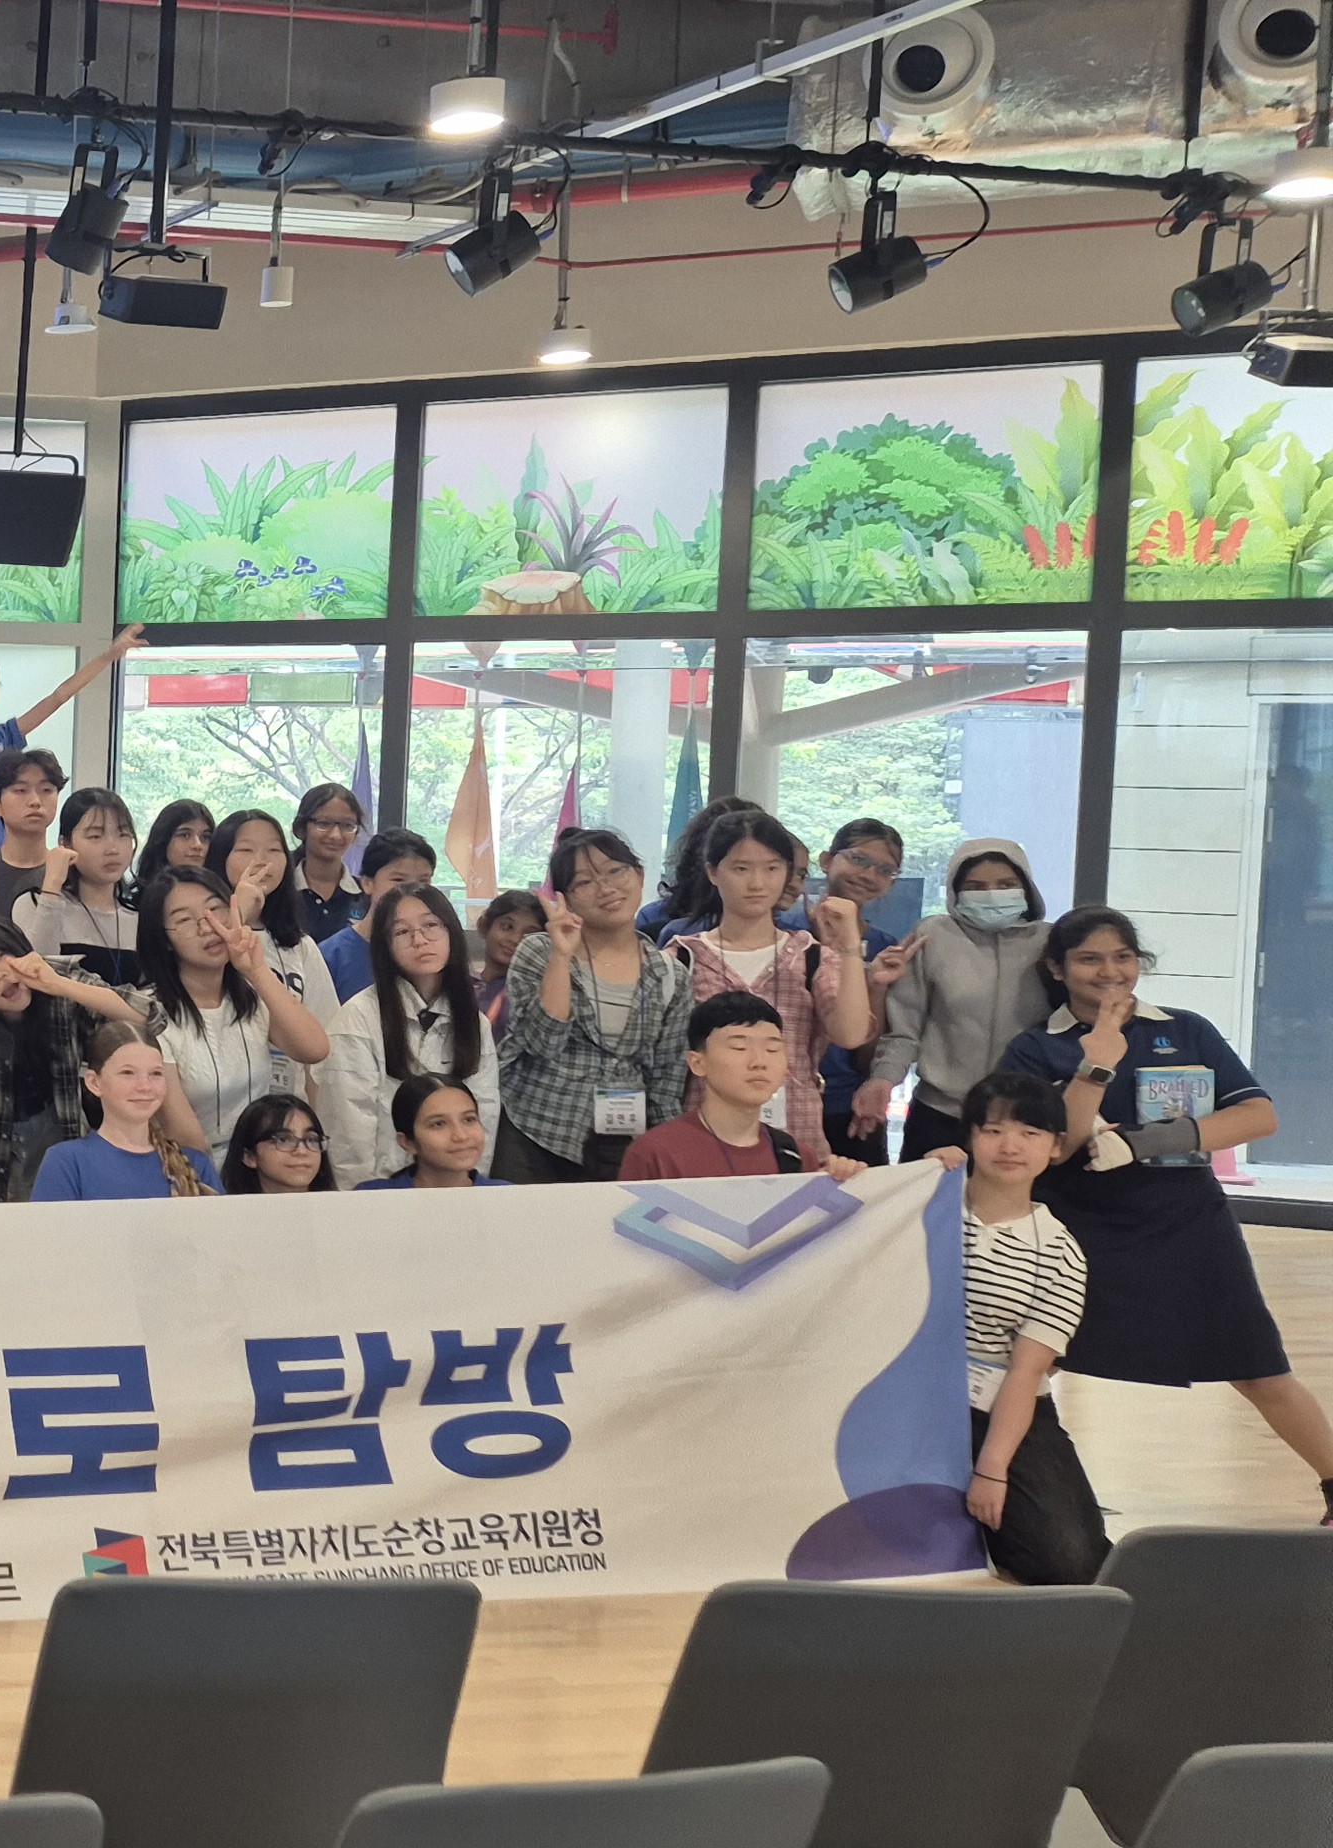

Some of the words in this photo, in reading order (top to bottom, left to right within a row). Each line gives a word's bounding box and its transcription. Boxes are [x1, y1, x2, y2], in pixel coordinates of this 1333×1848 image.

[242, 1321, 576, 1493] 탐방
[156, 1507, 605, 1572] 전북특별자치도순창교육지원청
[483, 1559, 507, 1576] OF
[509, 1552, 608, 1575] EDUCATION
